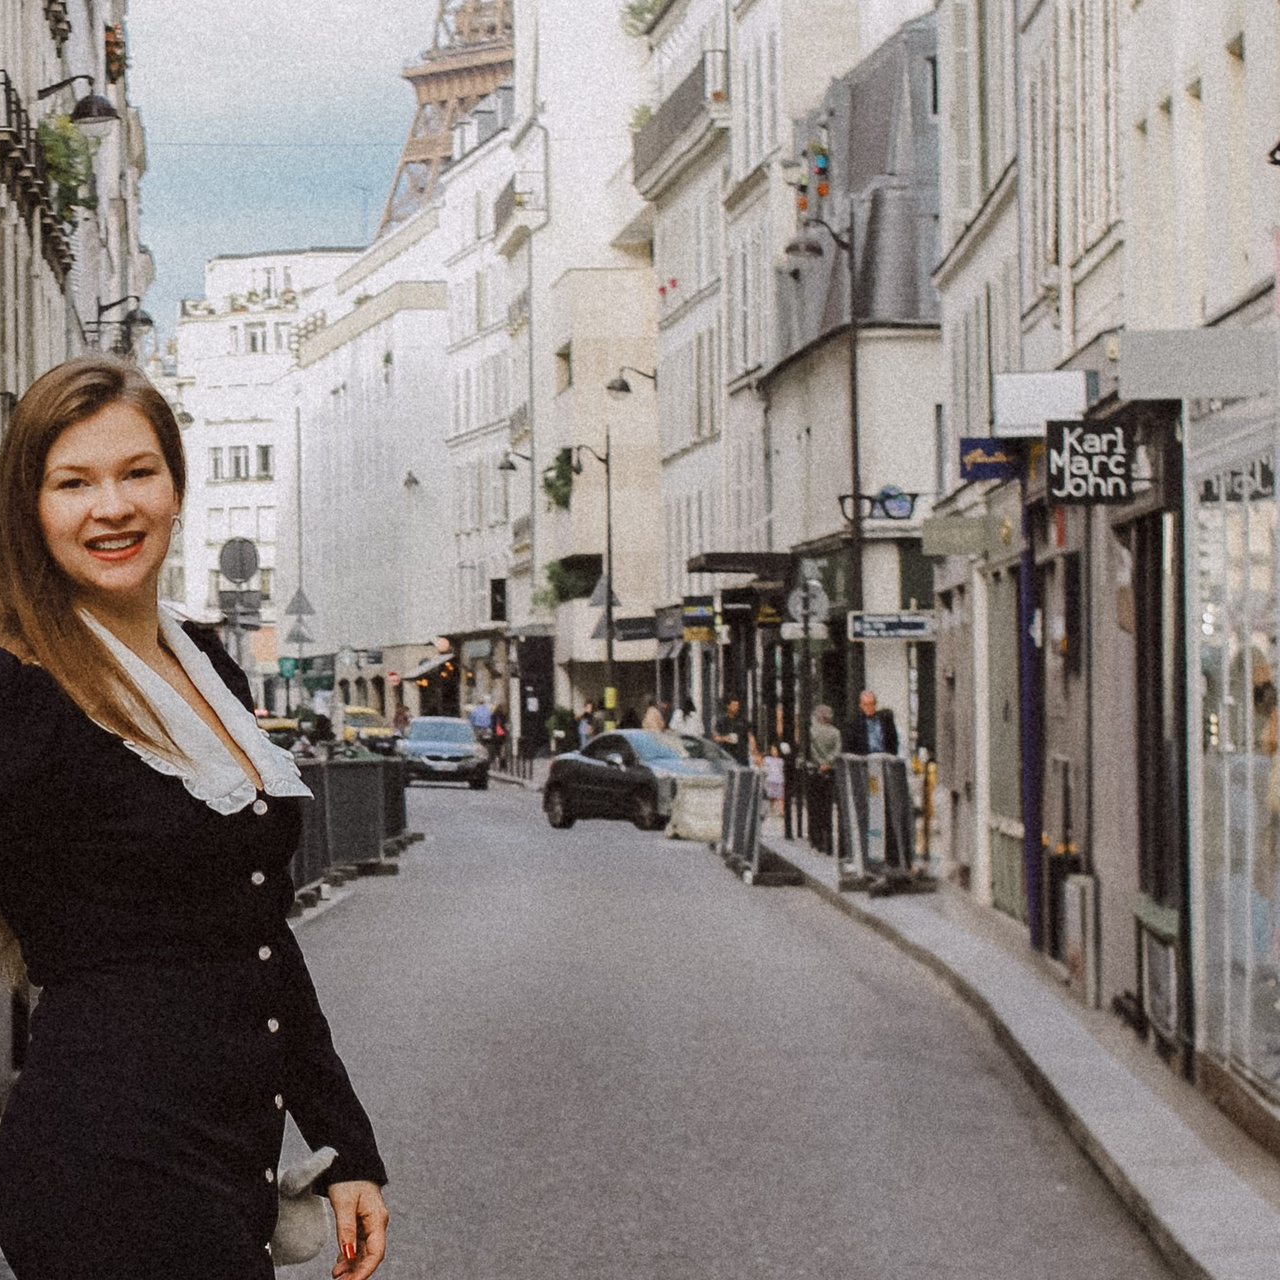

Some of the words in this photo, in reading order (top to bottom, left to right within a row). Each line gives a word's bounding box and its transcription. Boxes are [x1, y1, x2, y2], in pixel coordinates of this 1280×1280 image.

[1062, 426, 1127, 455] Karl
[1049, 448, 1126, 476] Marc
[1051, 469, 1127, 498] John
